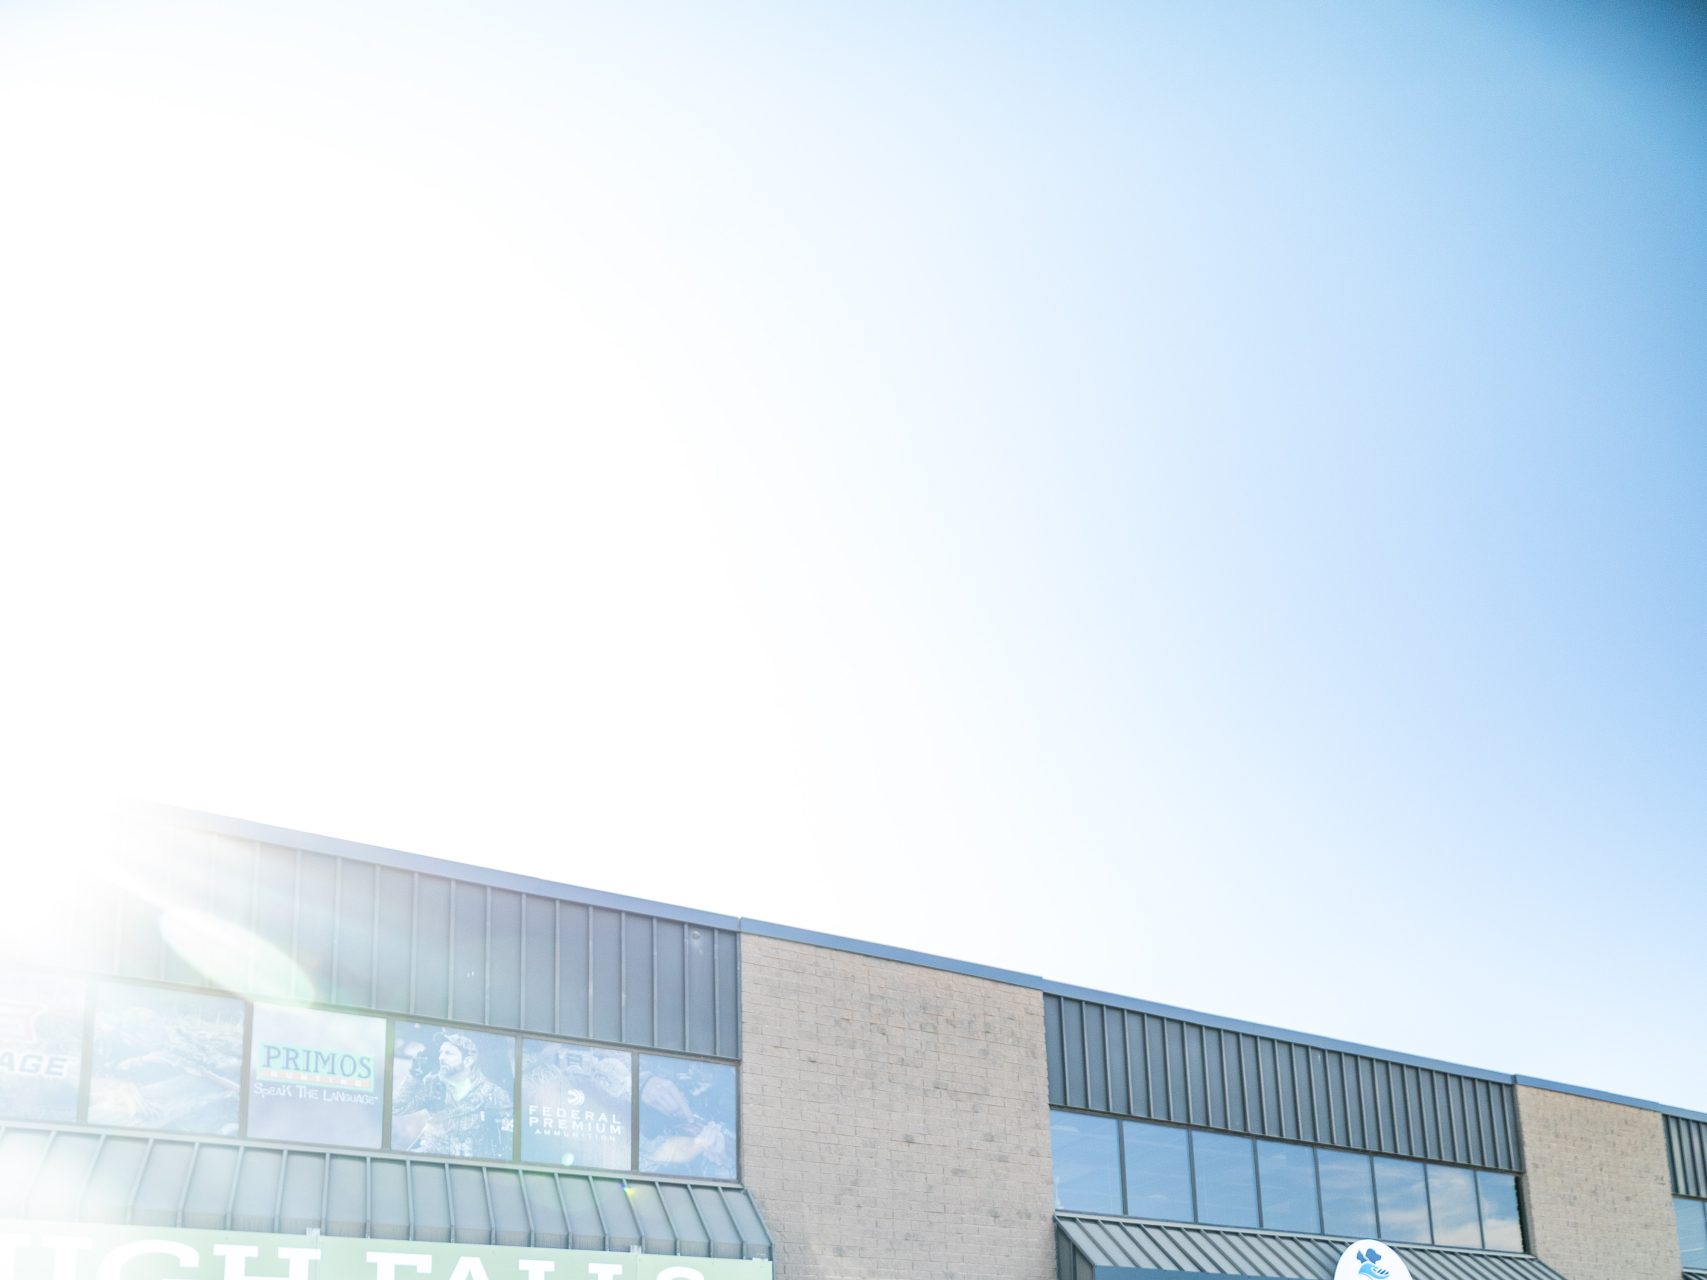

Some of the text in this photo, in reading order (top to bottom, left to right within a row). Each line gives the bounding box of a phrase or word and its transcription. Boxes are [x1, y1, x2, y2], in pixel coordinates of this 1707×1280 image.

[263, 1044, 372, 1079] PRIMOS
[296, 1085, 320, 1100] THE
[529, 1105, 622, 1125] FEDERAL
[529, 1117, 621, 1135] PREMIUM
